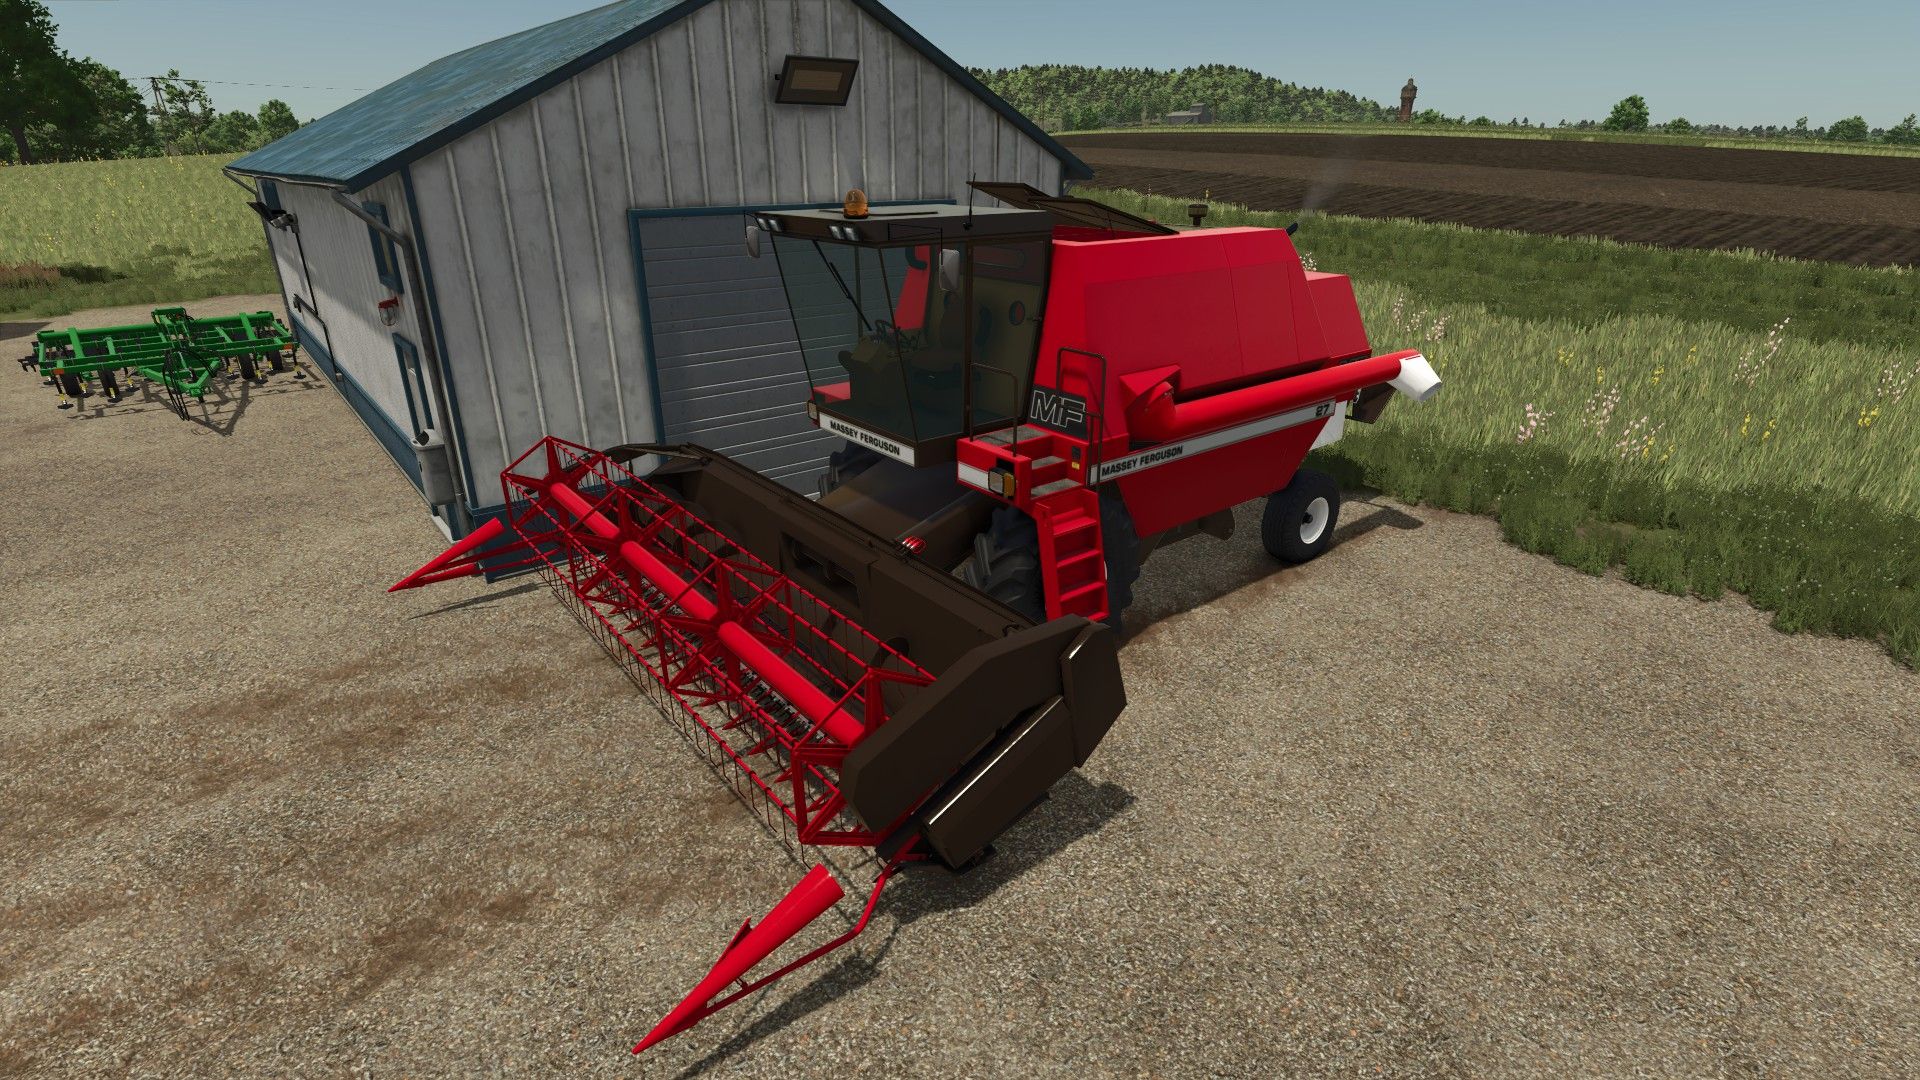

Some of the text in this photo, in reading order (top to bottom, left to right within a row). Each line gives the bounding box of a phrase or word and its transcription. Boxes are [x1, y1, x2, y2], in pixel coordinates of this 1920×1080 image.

[1030, 390, 1085, 428] MF
[830, 420, 900, 455] MASSEY FERGUSON
[1101, 445, 1183, 476] MASSEY FERGUSON
